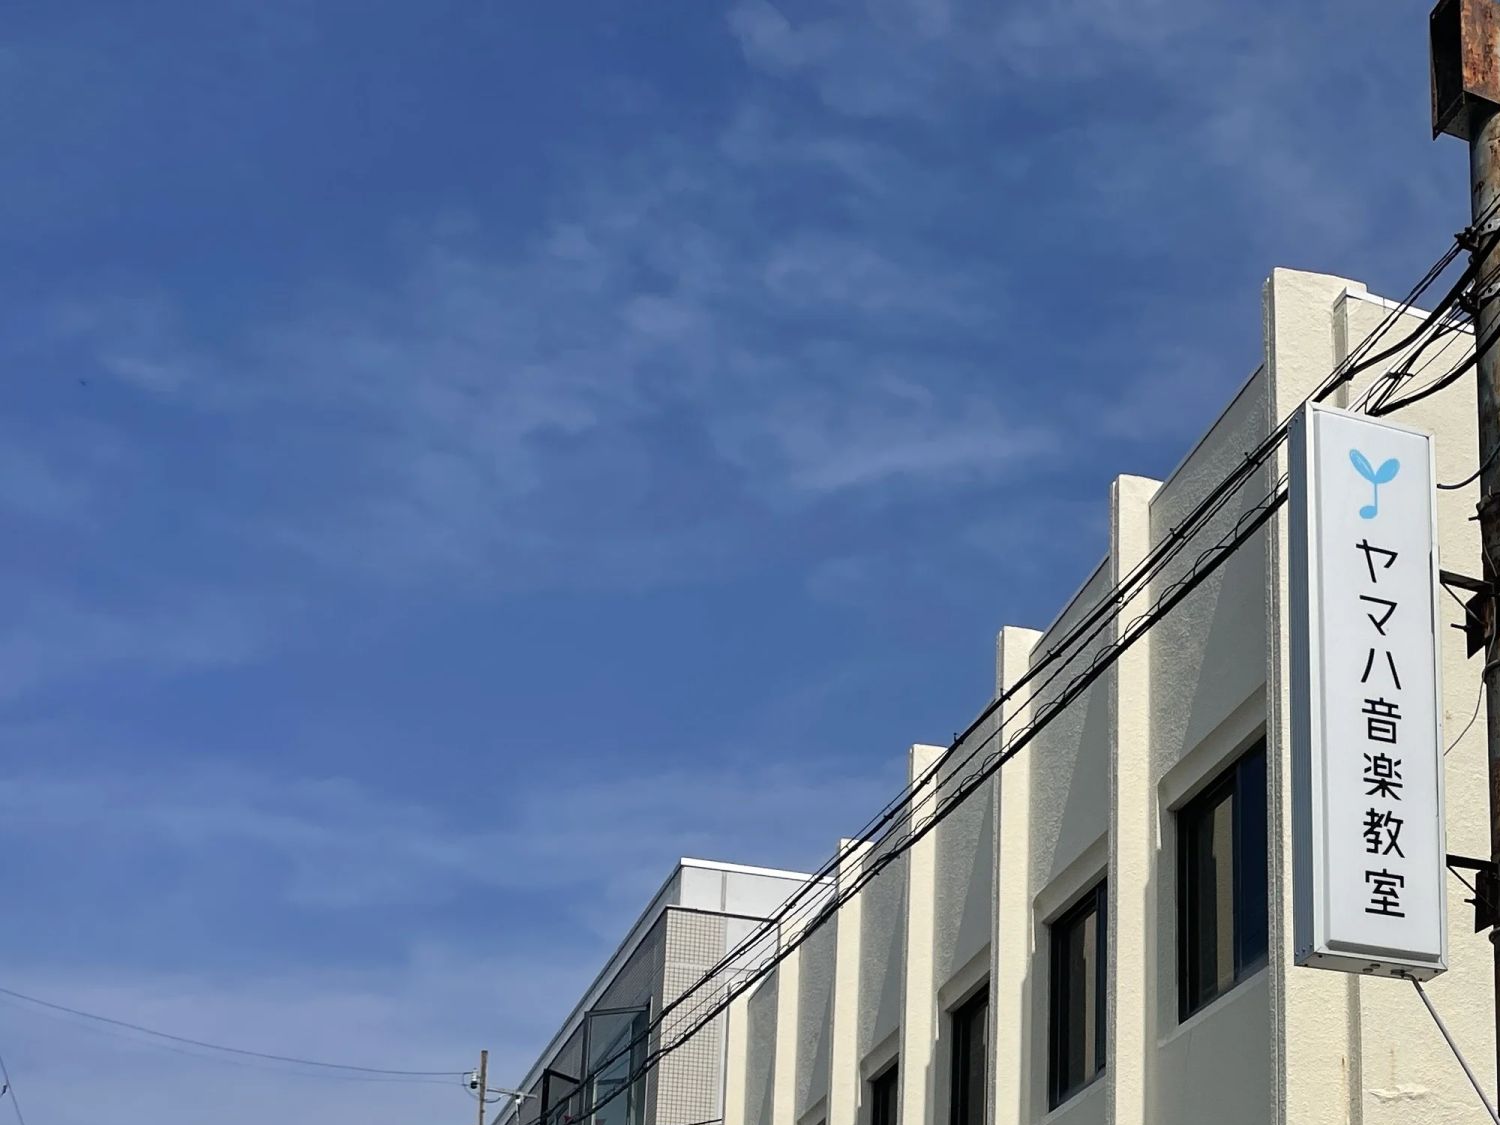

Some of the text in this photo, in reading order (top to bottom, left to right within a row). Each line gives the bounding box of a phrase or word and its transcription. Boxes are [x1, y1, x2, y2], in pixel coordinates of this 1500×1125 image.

[1354, 538, 1406, 919] ヤマハ音楽教室
